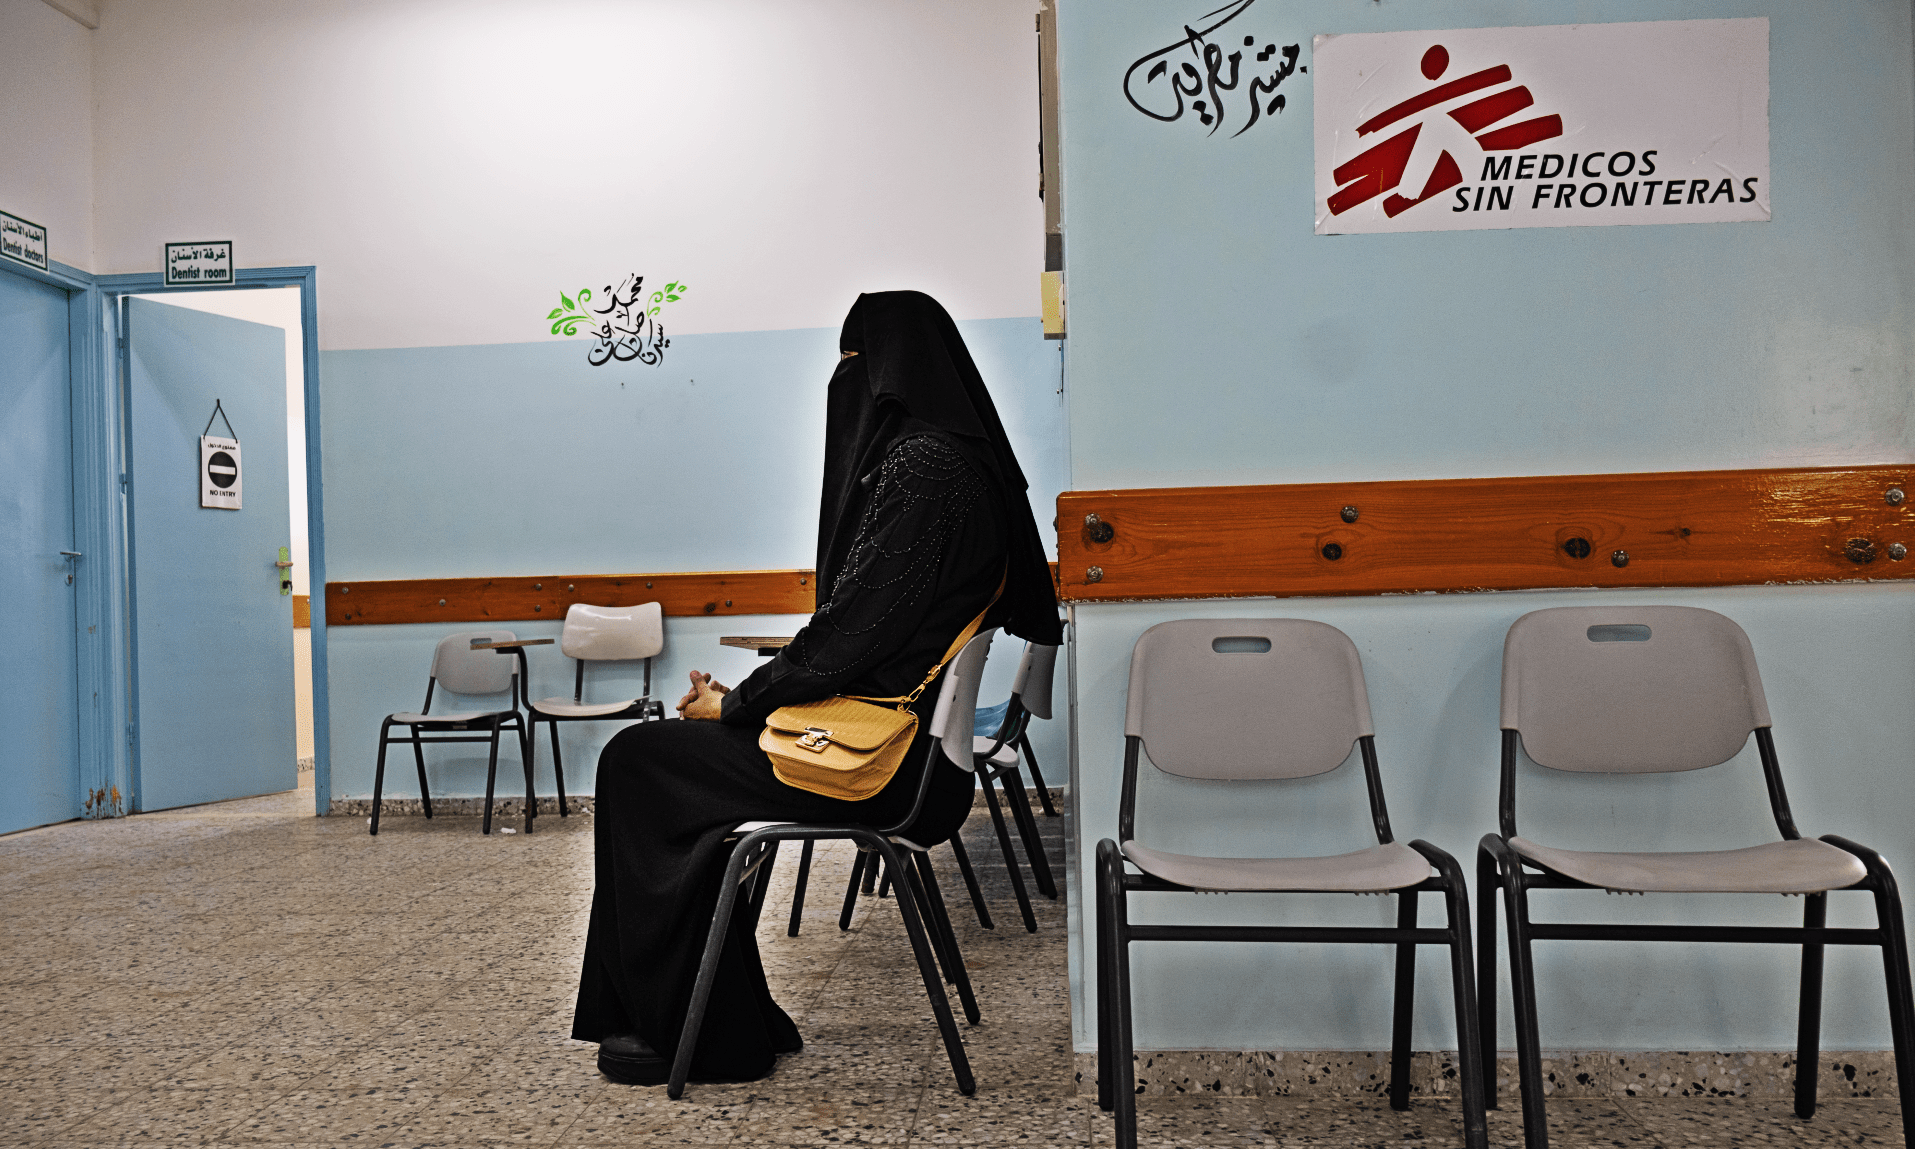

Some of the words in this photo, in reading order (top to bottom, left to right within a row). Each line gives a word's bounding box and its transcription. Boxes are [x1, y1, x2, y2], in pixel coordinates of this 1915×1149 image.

[1480, 149, 1659, 182] MEDICOS
[1452, 185, 1514, 213] SIN
[1532, 177, 1759, 210] FRONTERAS
[3, 237, 22, 256] Dentist
[24, 244, 44, 264] doctors
[203, 247, 227, 262] غرفة
[171, 265, 200, 280] Dentist
[204, 268, 227, 279] room
